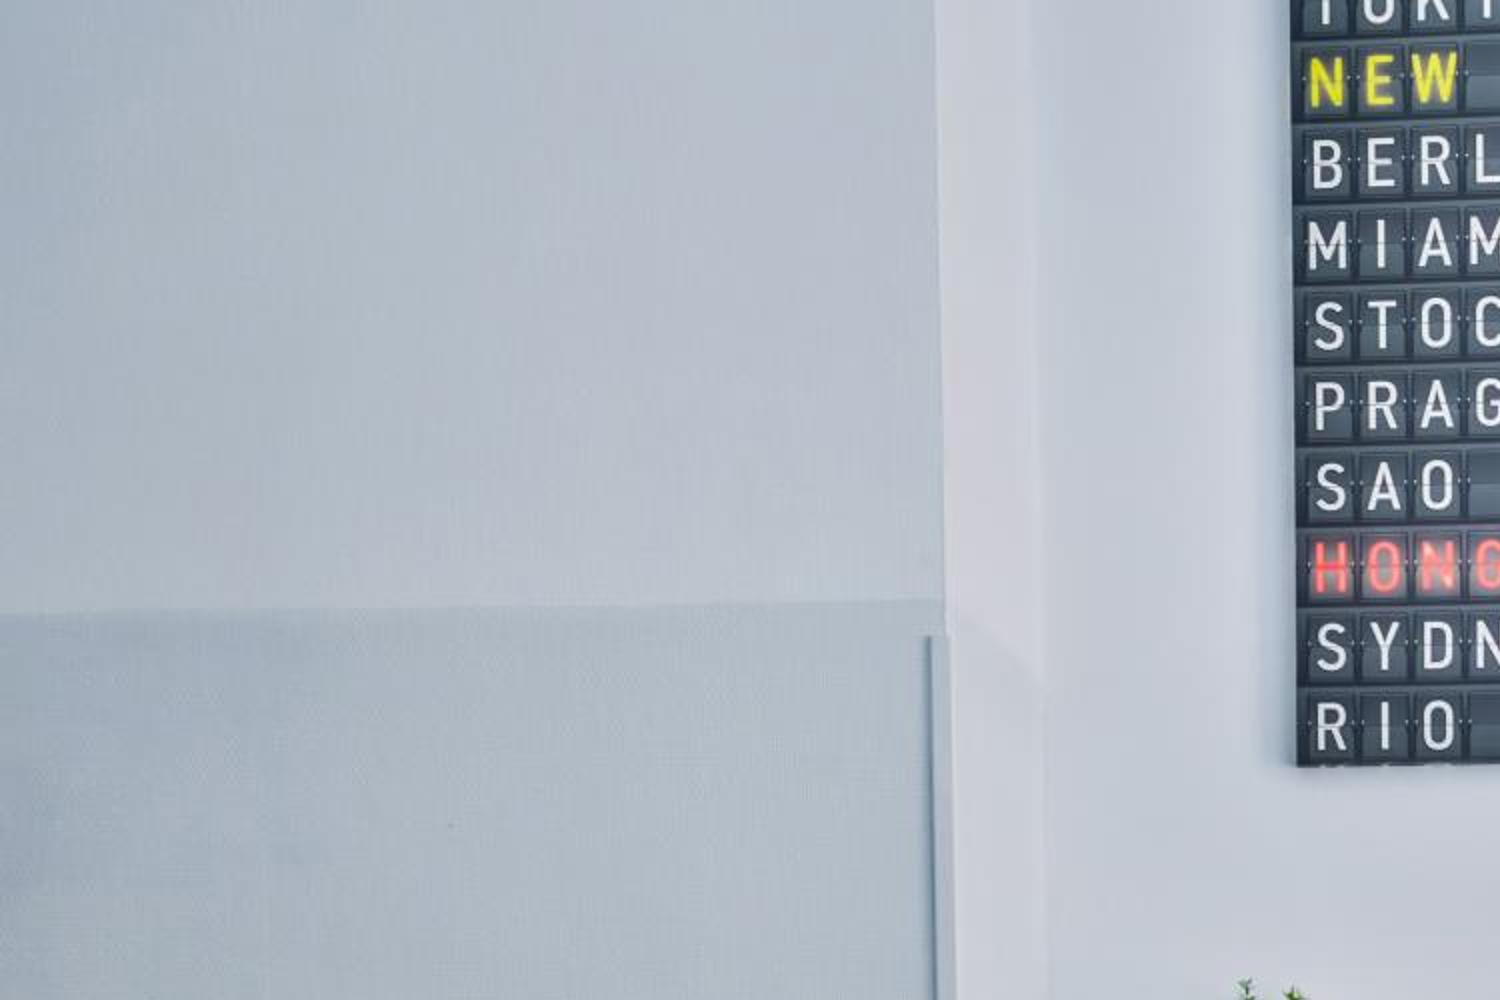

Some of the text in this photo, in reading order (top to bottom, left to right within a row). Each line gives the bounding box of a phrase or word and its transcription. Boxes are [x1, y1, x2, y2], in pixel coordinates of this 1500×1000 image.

[1310, 52, 1457, 107] NEW
[1316, 459, 1453, 511] SAO
[1317, 699, 1454, 751] RIO
